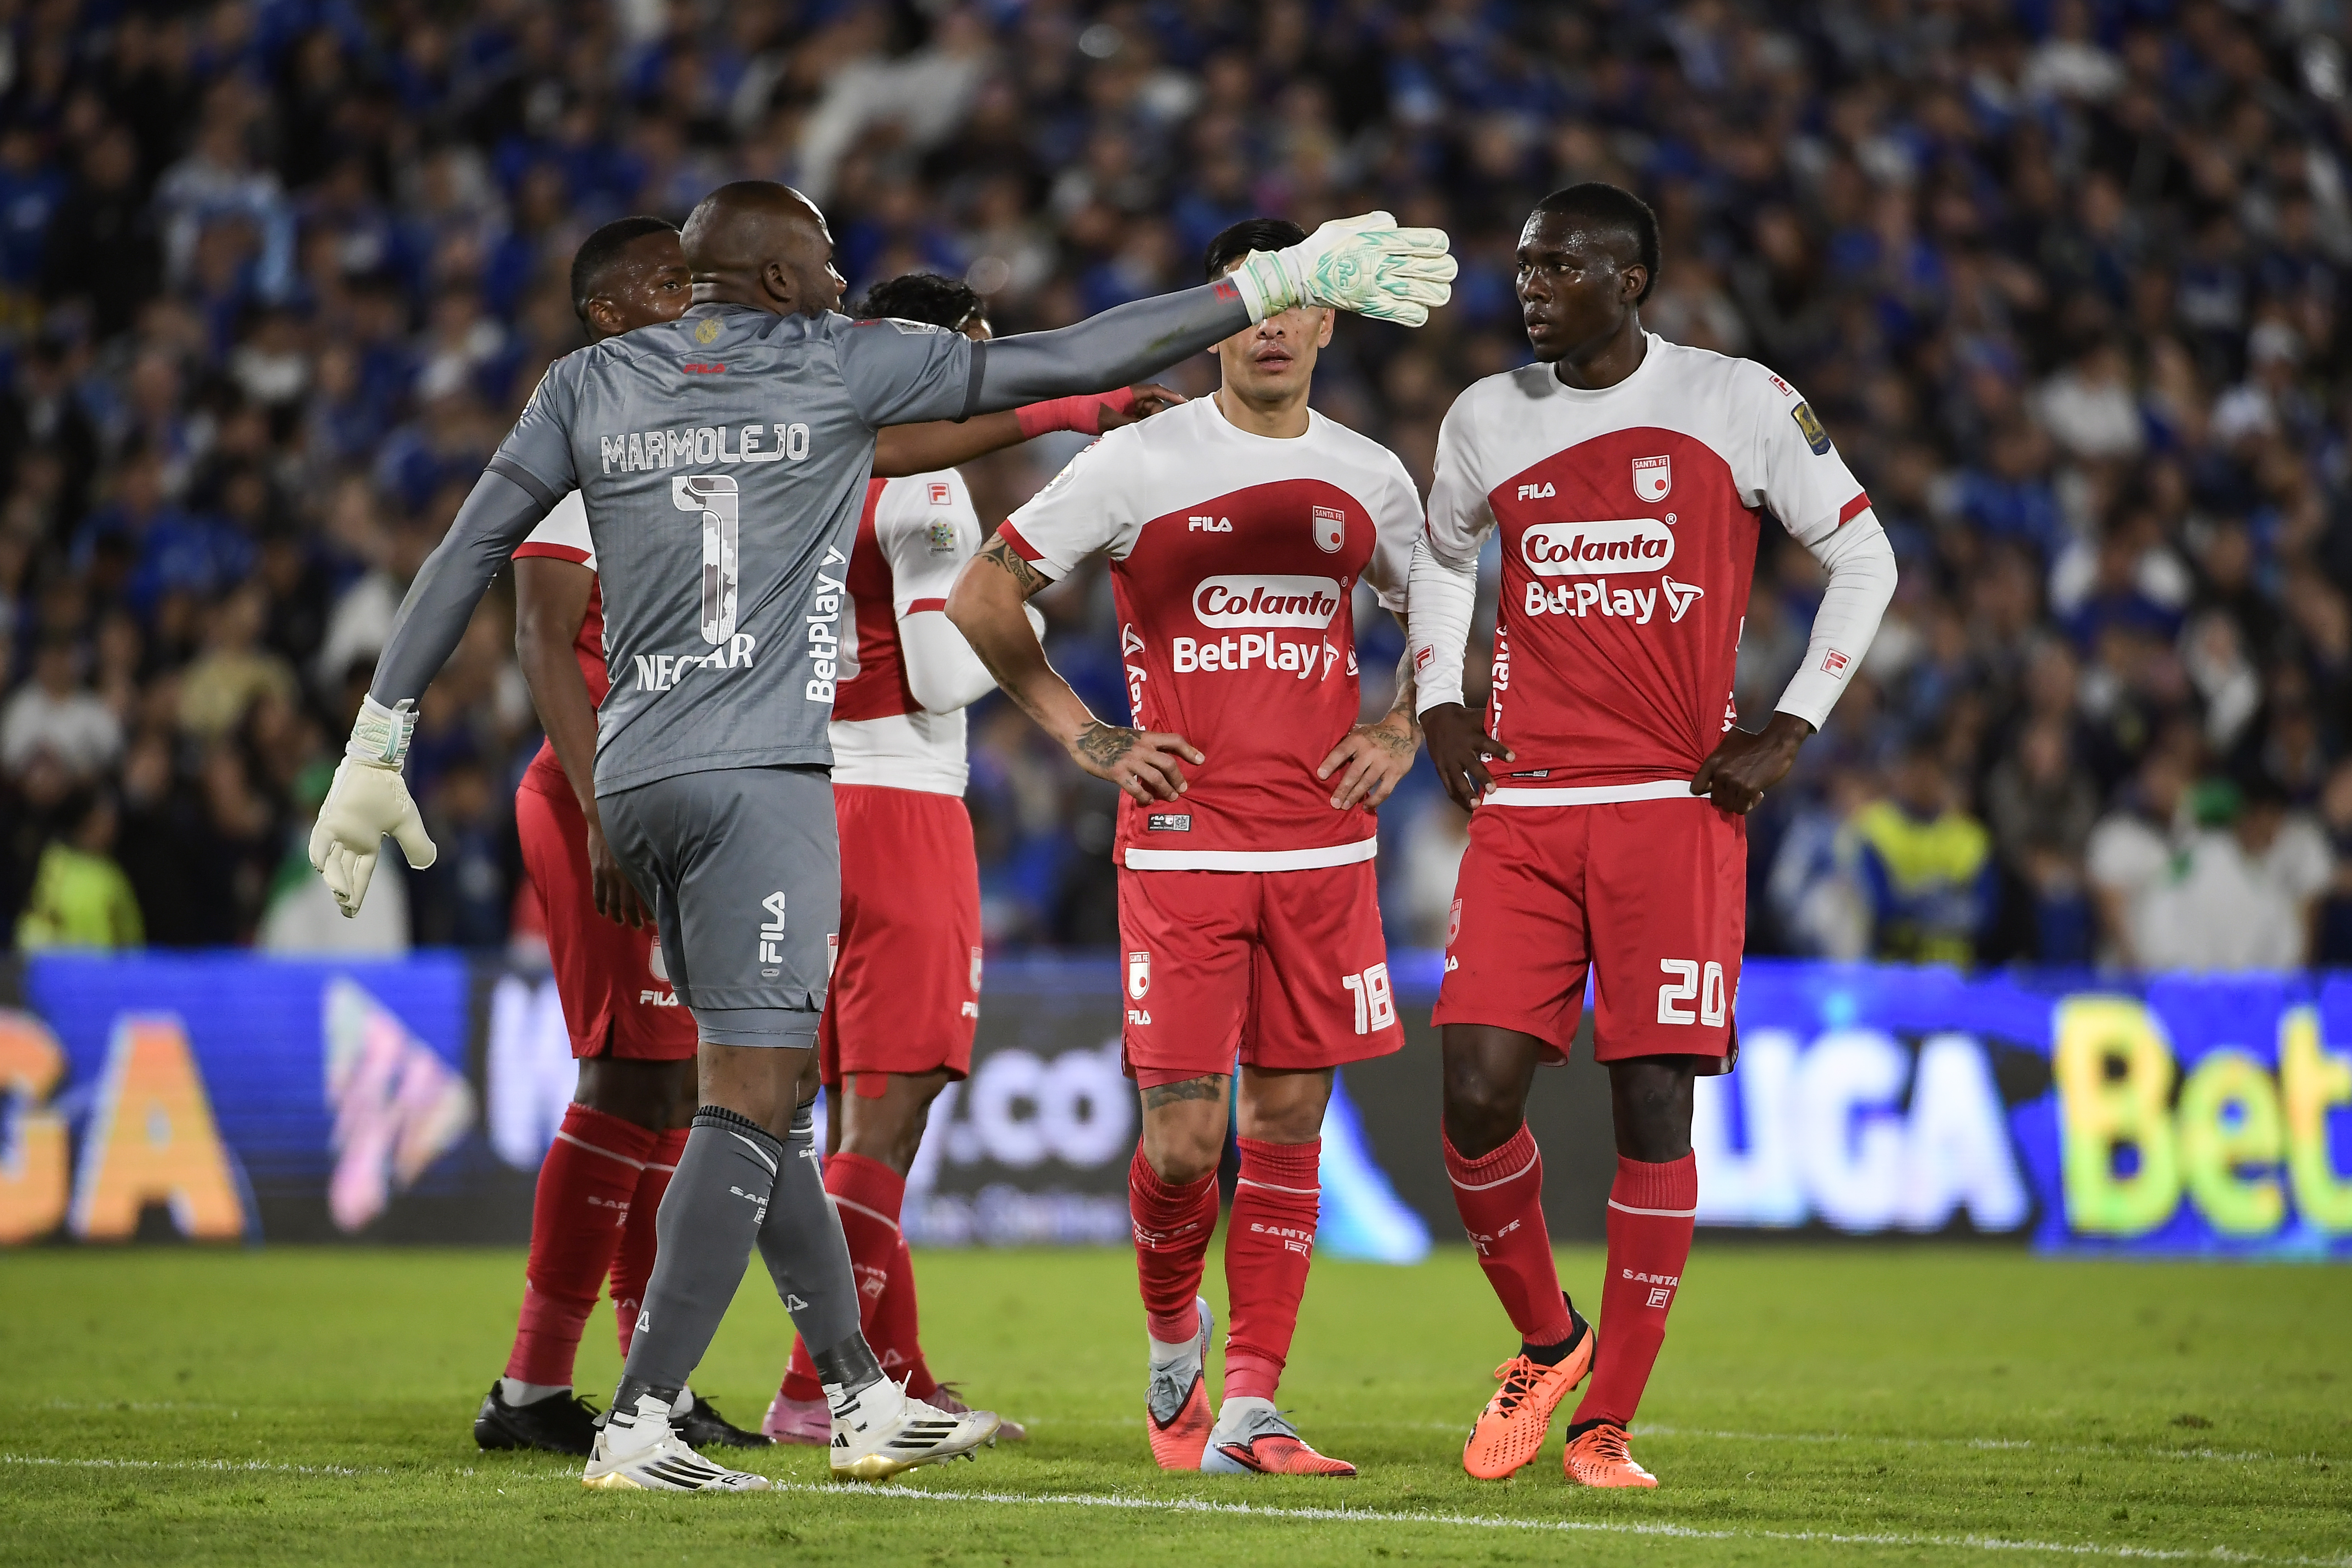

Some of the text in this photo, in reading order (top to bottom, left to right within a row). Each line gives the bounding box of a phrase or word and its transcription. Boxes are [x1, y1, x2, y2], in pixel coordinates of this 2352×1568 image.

[683, 363, 726, 374] FILA
[601, 423, 810, 474] MARMOLEJO
[1635, 460, 1657, 468] SANTA
[1518, 482, 1556, 501] FILA
[1188, 516, 1233, 532] FILA
[1315, 509, 1334, 519] SANTA
[672, 474, 738, 645] 1
[1525, 533, 1668, 564] Colanta
[1197, 585, 1336, 616] Colanta
[1525, 578, 1657, 625] BetPlay
[806, 572, 846, 704] BetPlay
[1173, 631, 1319, 680] BetPlay
[759, 891, 785, 963] FILA
[639, 990, 679, 1006] FILA
[1342, 962, 1395, 1035] 18
[1657, 958, 1726, 1027] 20
[1128, 1010, 1151, 1025] FILA
[1251, 1222, 1313, 1244] SANTA
[1498, 1219, 1520, 1238] FE
[1622, 1268, 1678, 1287] SANTA
